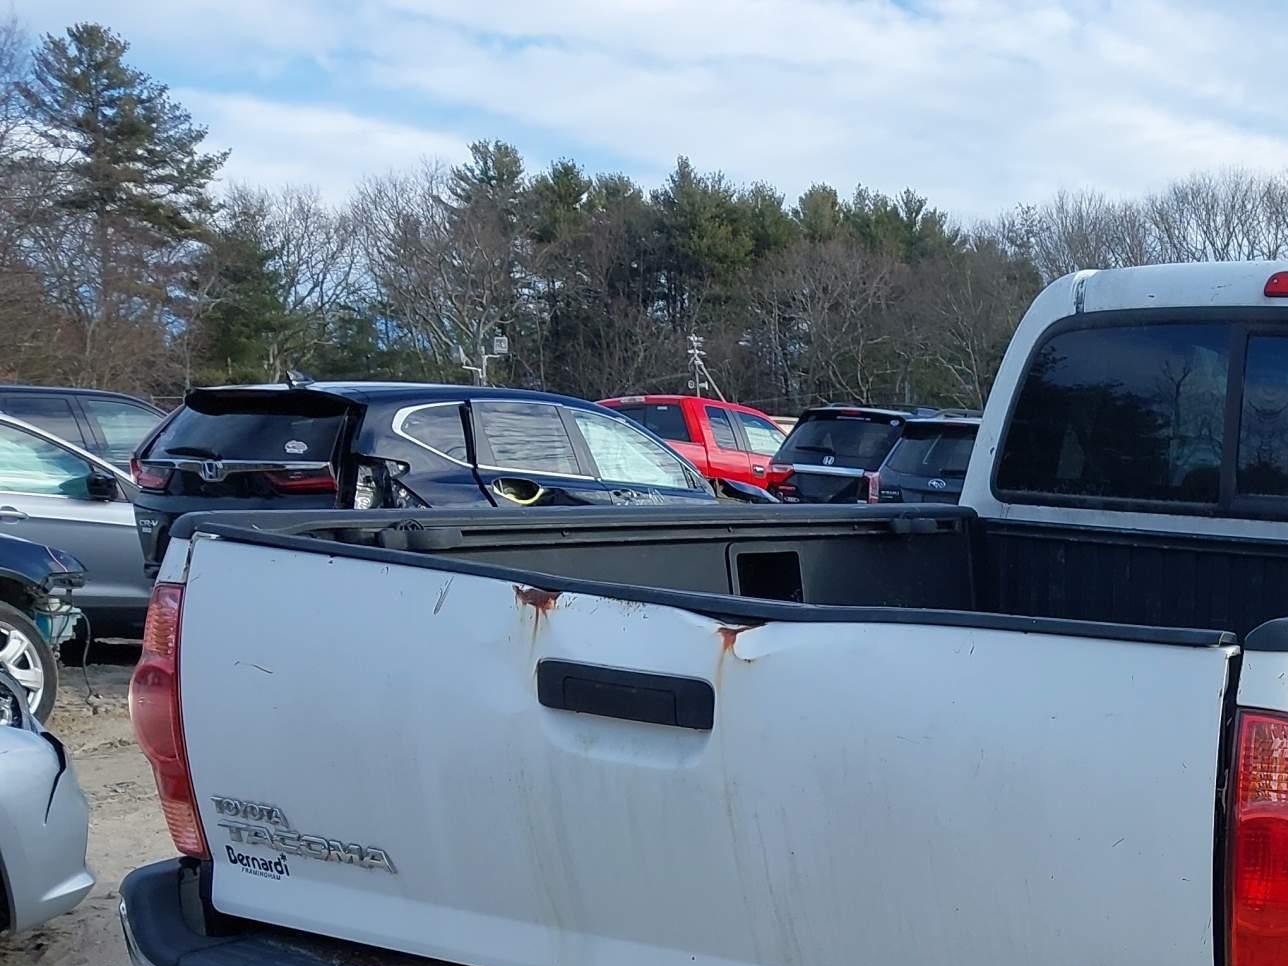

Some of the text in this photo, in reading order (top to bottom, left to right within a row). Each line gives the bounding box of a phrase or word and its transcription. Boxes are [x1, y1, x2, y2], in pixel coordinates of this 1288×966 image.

[209, 794, 289, 829] TOYOTA
[217, 818, 398, 875] TACOMA
[225, 844, 290, 877] Bernardi
